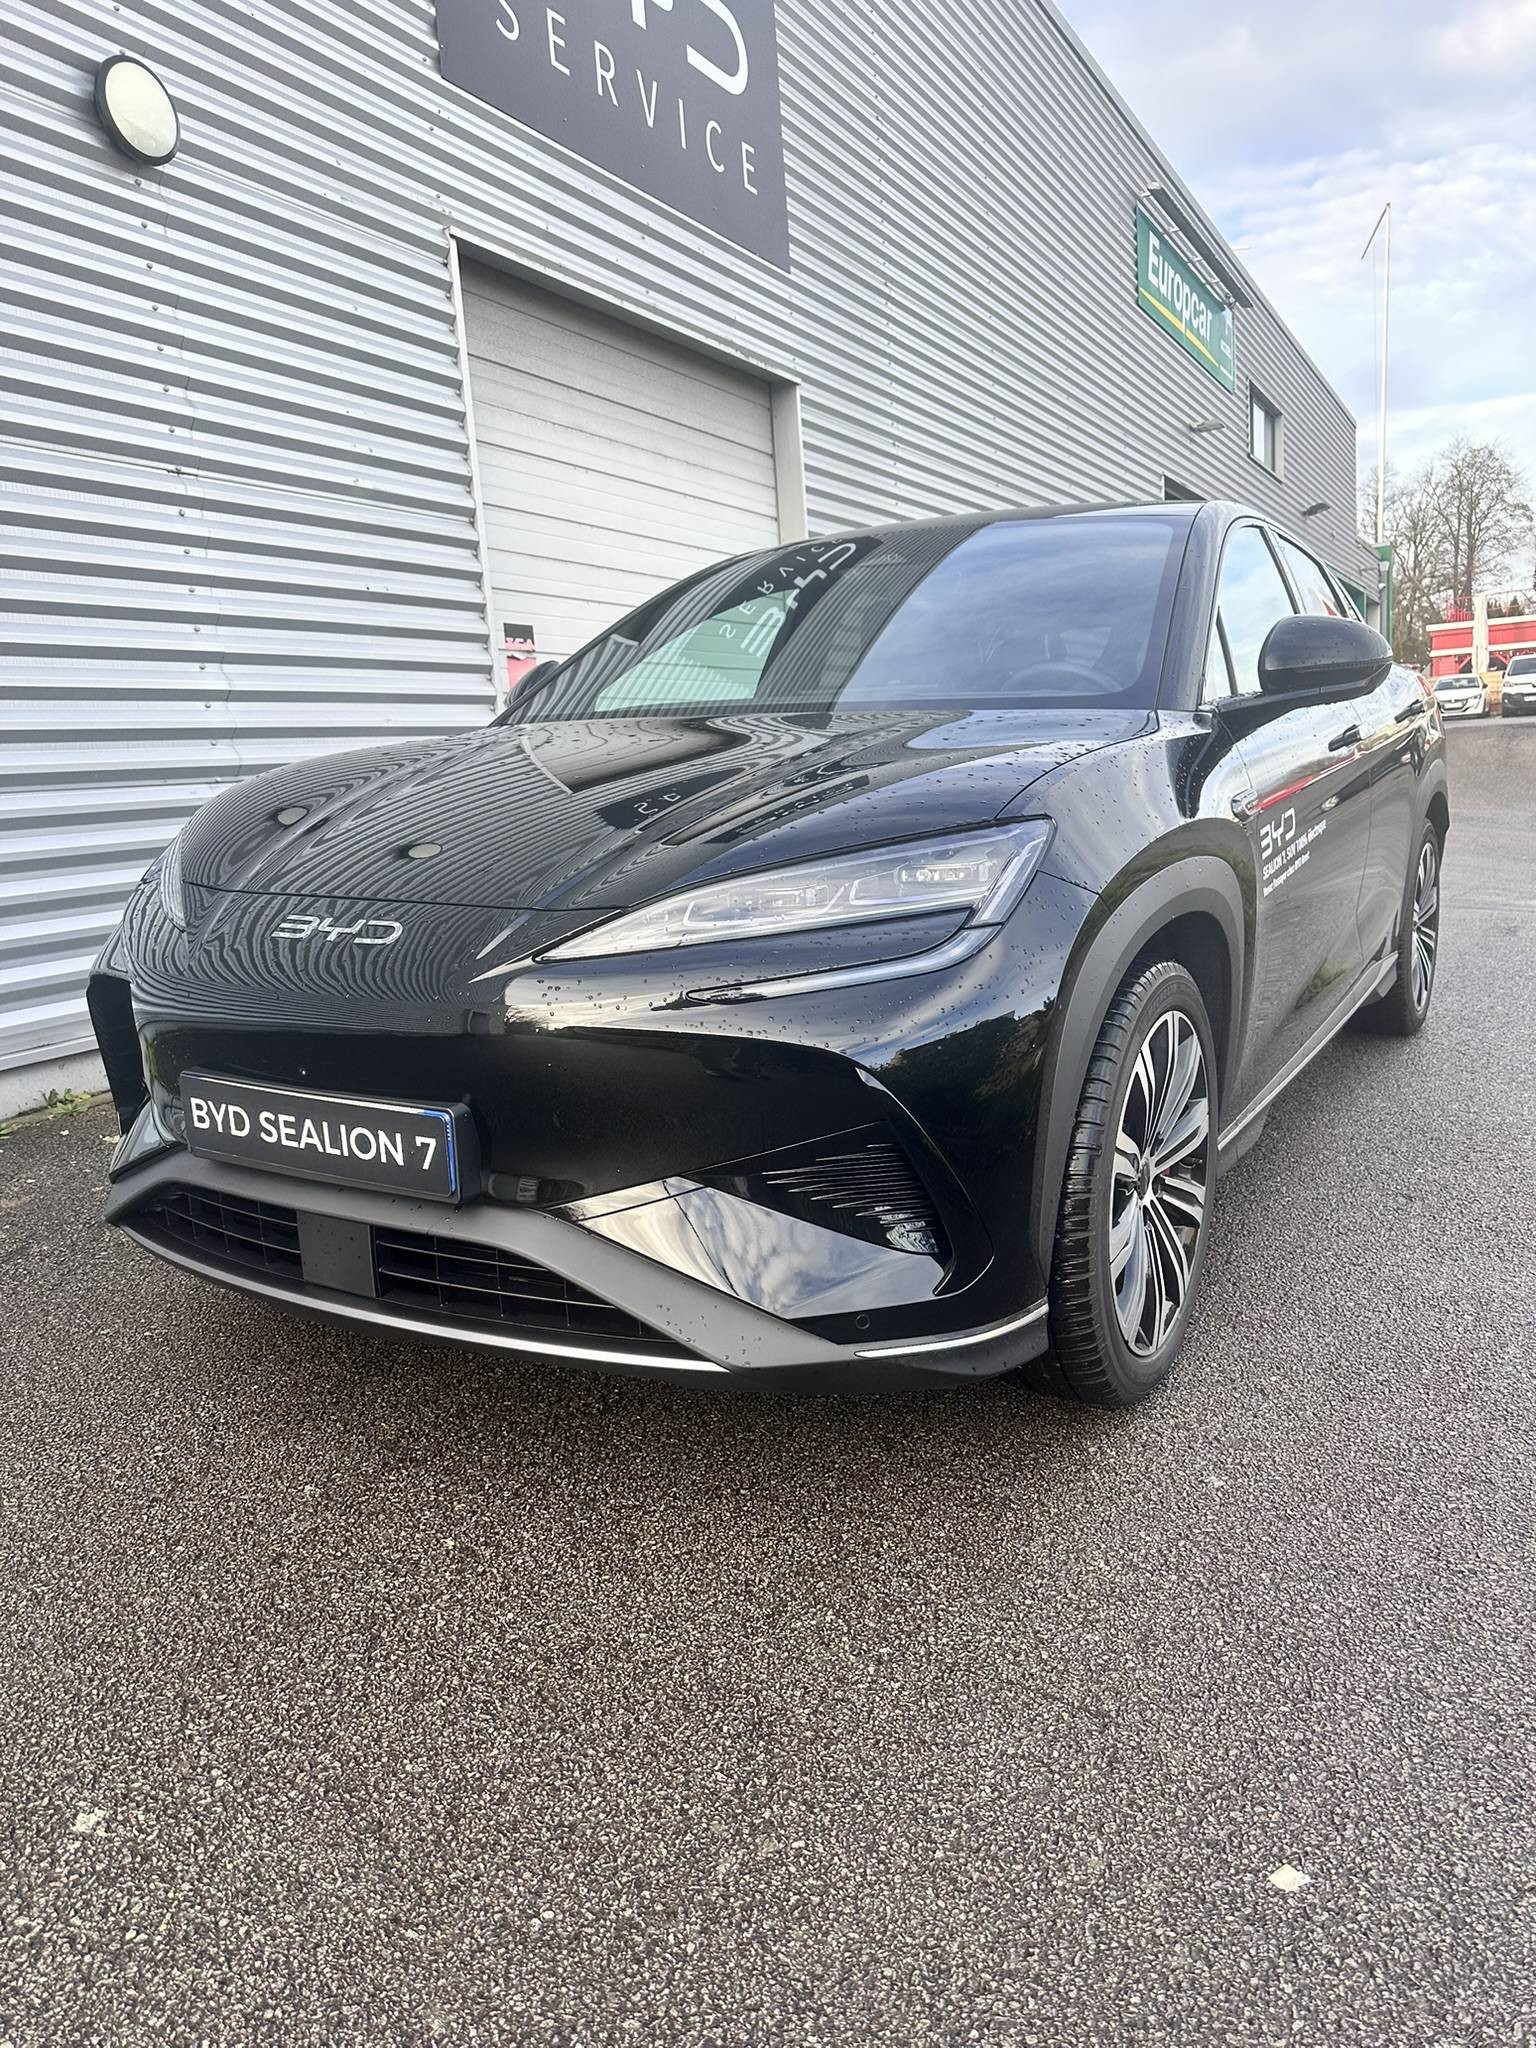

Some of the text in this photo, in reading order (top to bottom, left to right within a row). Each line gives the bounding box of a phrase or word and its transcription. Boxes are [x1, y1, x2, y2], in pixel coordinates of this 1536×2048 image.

[495, 0, 758, 196] SERVICE
[1147, 229, 1213, 342] Europcar
[1260, 808, 1296, 860] BYD
[271, 914, 404, 945] BYD
[189, 1096, 438, 1171] BYD SEALION 7
